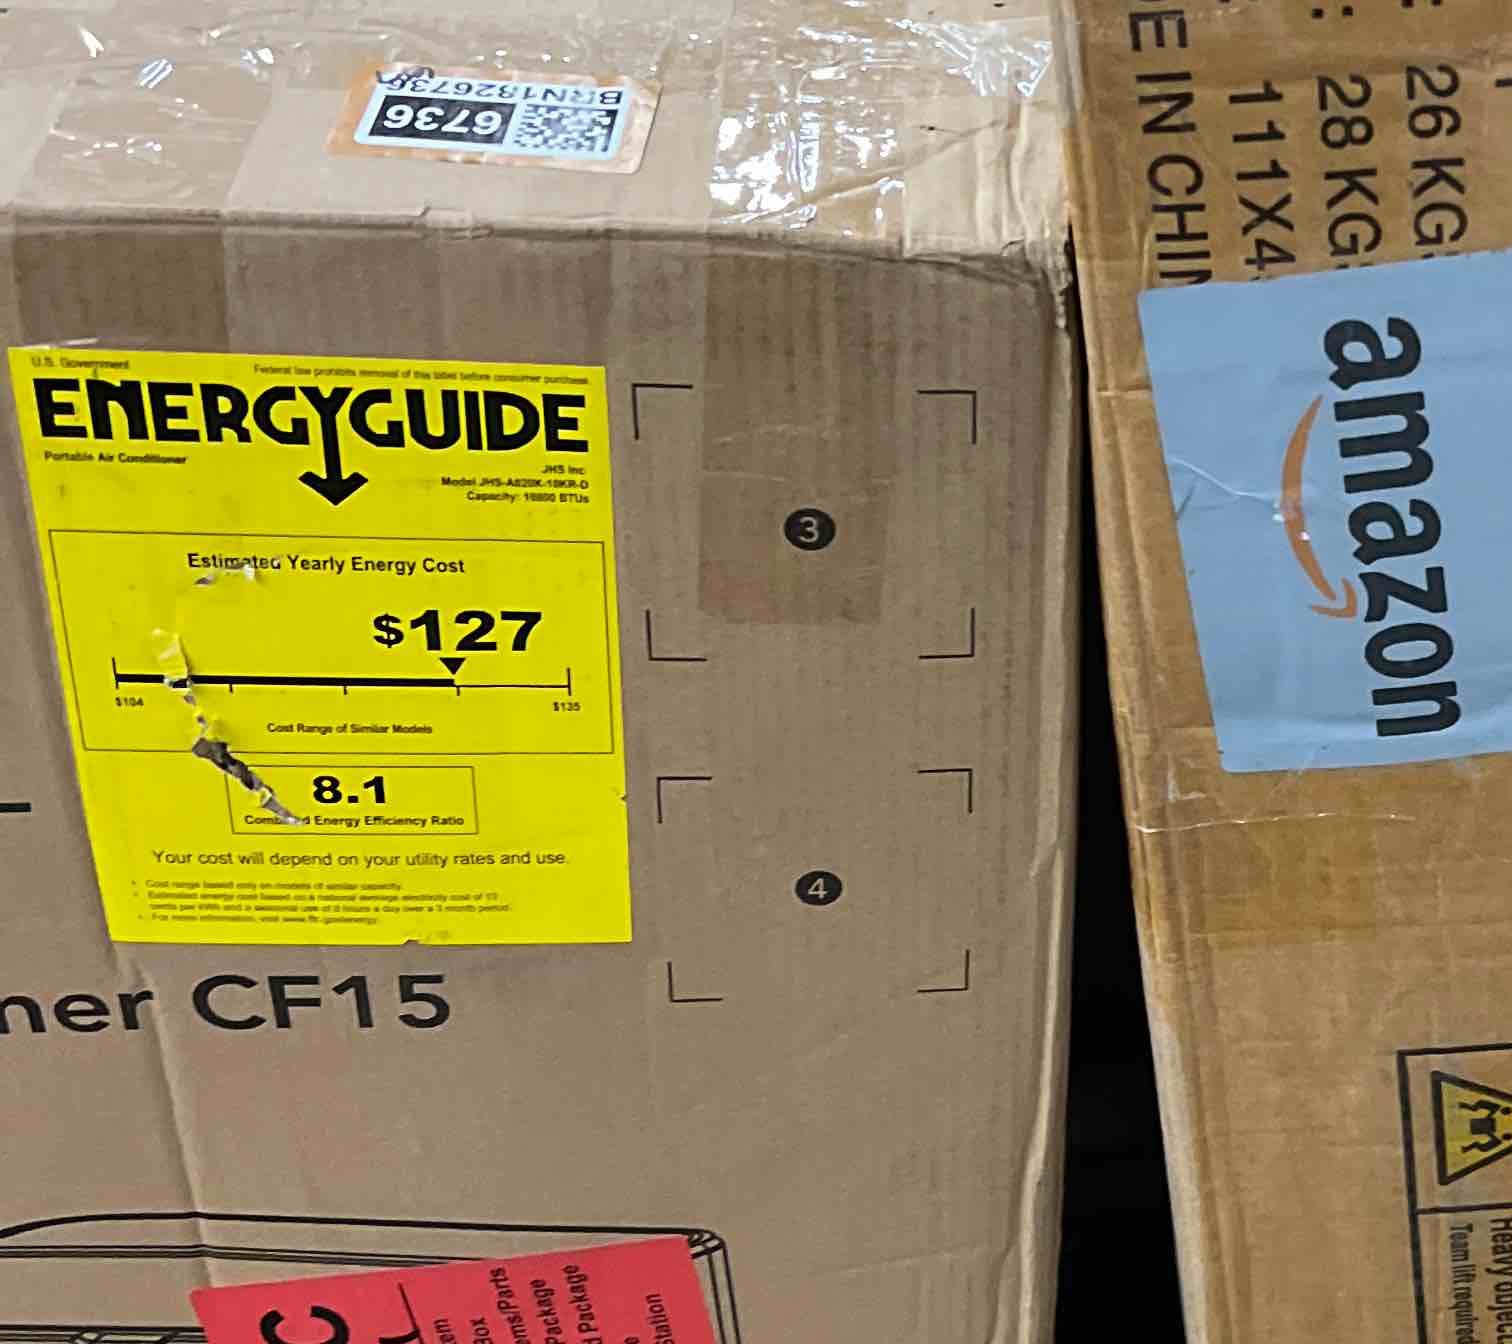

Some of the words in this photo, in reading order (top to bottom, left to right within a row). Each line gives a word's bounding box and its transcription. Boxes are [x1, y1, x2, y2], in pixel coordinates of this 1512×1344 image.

[383, 103, 504, 136] 6736
[1135, 71, 1197, 135] IN
[1323, 166, 1383, 267] KG
[1410, 157, 1468, 258] KG
[32, 377, 591, 456] ENERGYGUIDE
[44, 450, 94, 463] Portable
[98, 451, 115, 463] Air
[118, 452, 188, 465] Conditioner
[441, 477, 478, 489] Model
[1322, 315, 1462, 738] amazon
[287, 554, 345, 574] Yearly
[351, 556, 416, 576] Energy
[422, 557, 466, 574] Cost
[372, 609, 543, 653] $127
[266, 722, 294, 734] Cost
[297, 722, 333, 737] Range
[336, 722, 348, 735] of
[350, 722, 389, 736] Similar
[392, 723, 433, 736] Models
[312, 775, 388, 805] 8.1
[315, 814, 360, 829] Energy
[364, 814, 427, 829] Efficiency
[431, 815, 465, 827] Ratio
[152, 849, 193, 866] Your
[198, 851, 233, 866] cost
[239, 850, 264, 866] will
[269, 850, 332, 870] depend
[338, 854, 358, 867] on
[363, 853, 401, 871] your
[405, 851, 448, 870] utility
[452, 851, 495, 867] rates
[499, 851, 531, 866] and
[191, 973, 451, 1031] CF15
[1448, 1223, 1474, 1262] Team
[1452, 1263, 1477, 1285] lift
[563, 1263, 597, 1334] Package
